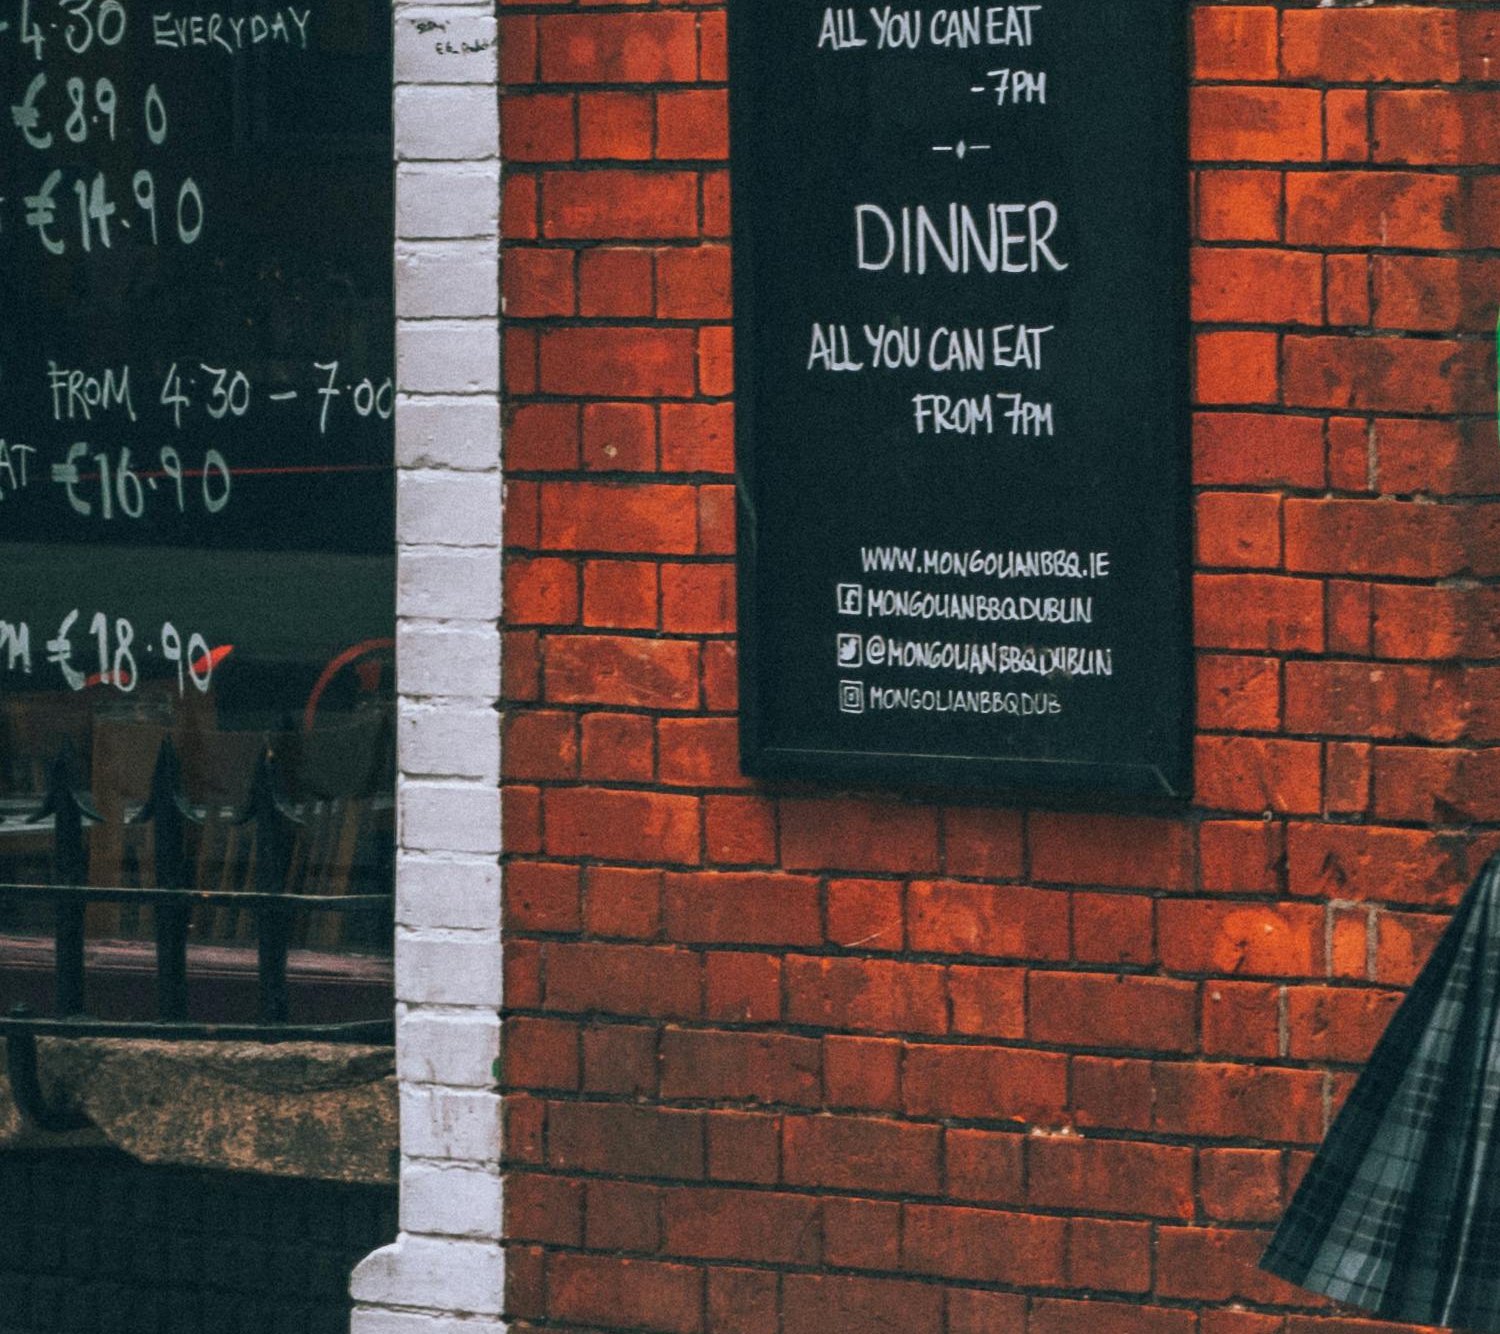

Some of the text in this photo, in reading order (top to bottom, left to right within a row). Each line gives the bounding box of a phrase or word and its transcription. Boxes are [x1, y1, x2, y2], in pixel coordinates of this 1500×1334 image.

[152, 6, 311, 55] EVERYDAY
[817, 5, 1042, 51] ALL YOU CAN EAT
[970, 68, 1046, 106] -7PM
[855, 200, 1070, 275] DINNER
[807, 322, 1054, 372] ALL YOU CAN EAT
[48, 360, 137, 423] FROM
[912, 393, 1054, 437] FROM 7PM
[867, 588, 1093, 624] MONGOLIANBBQDUBLIN
